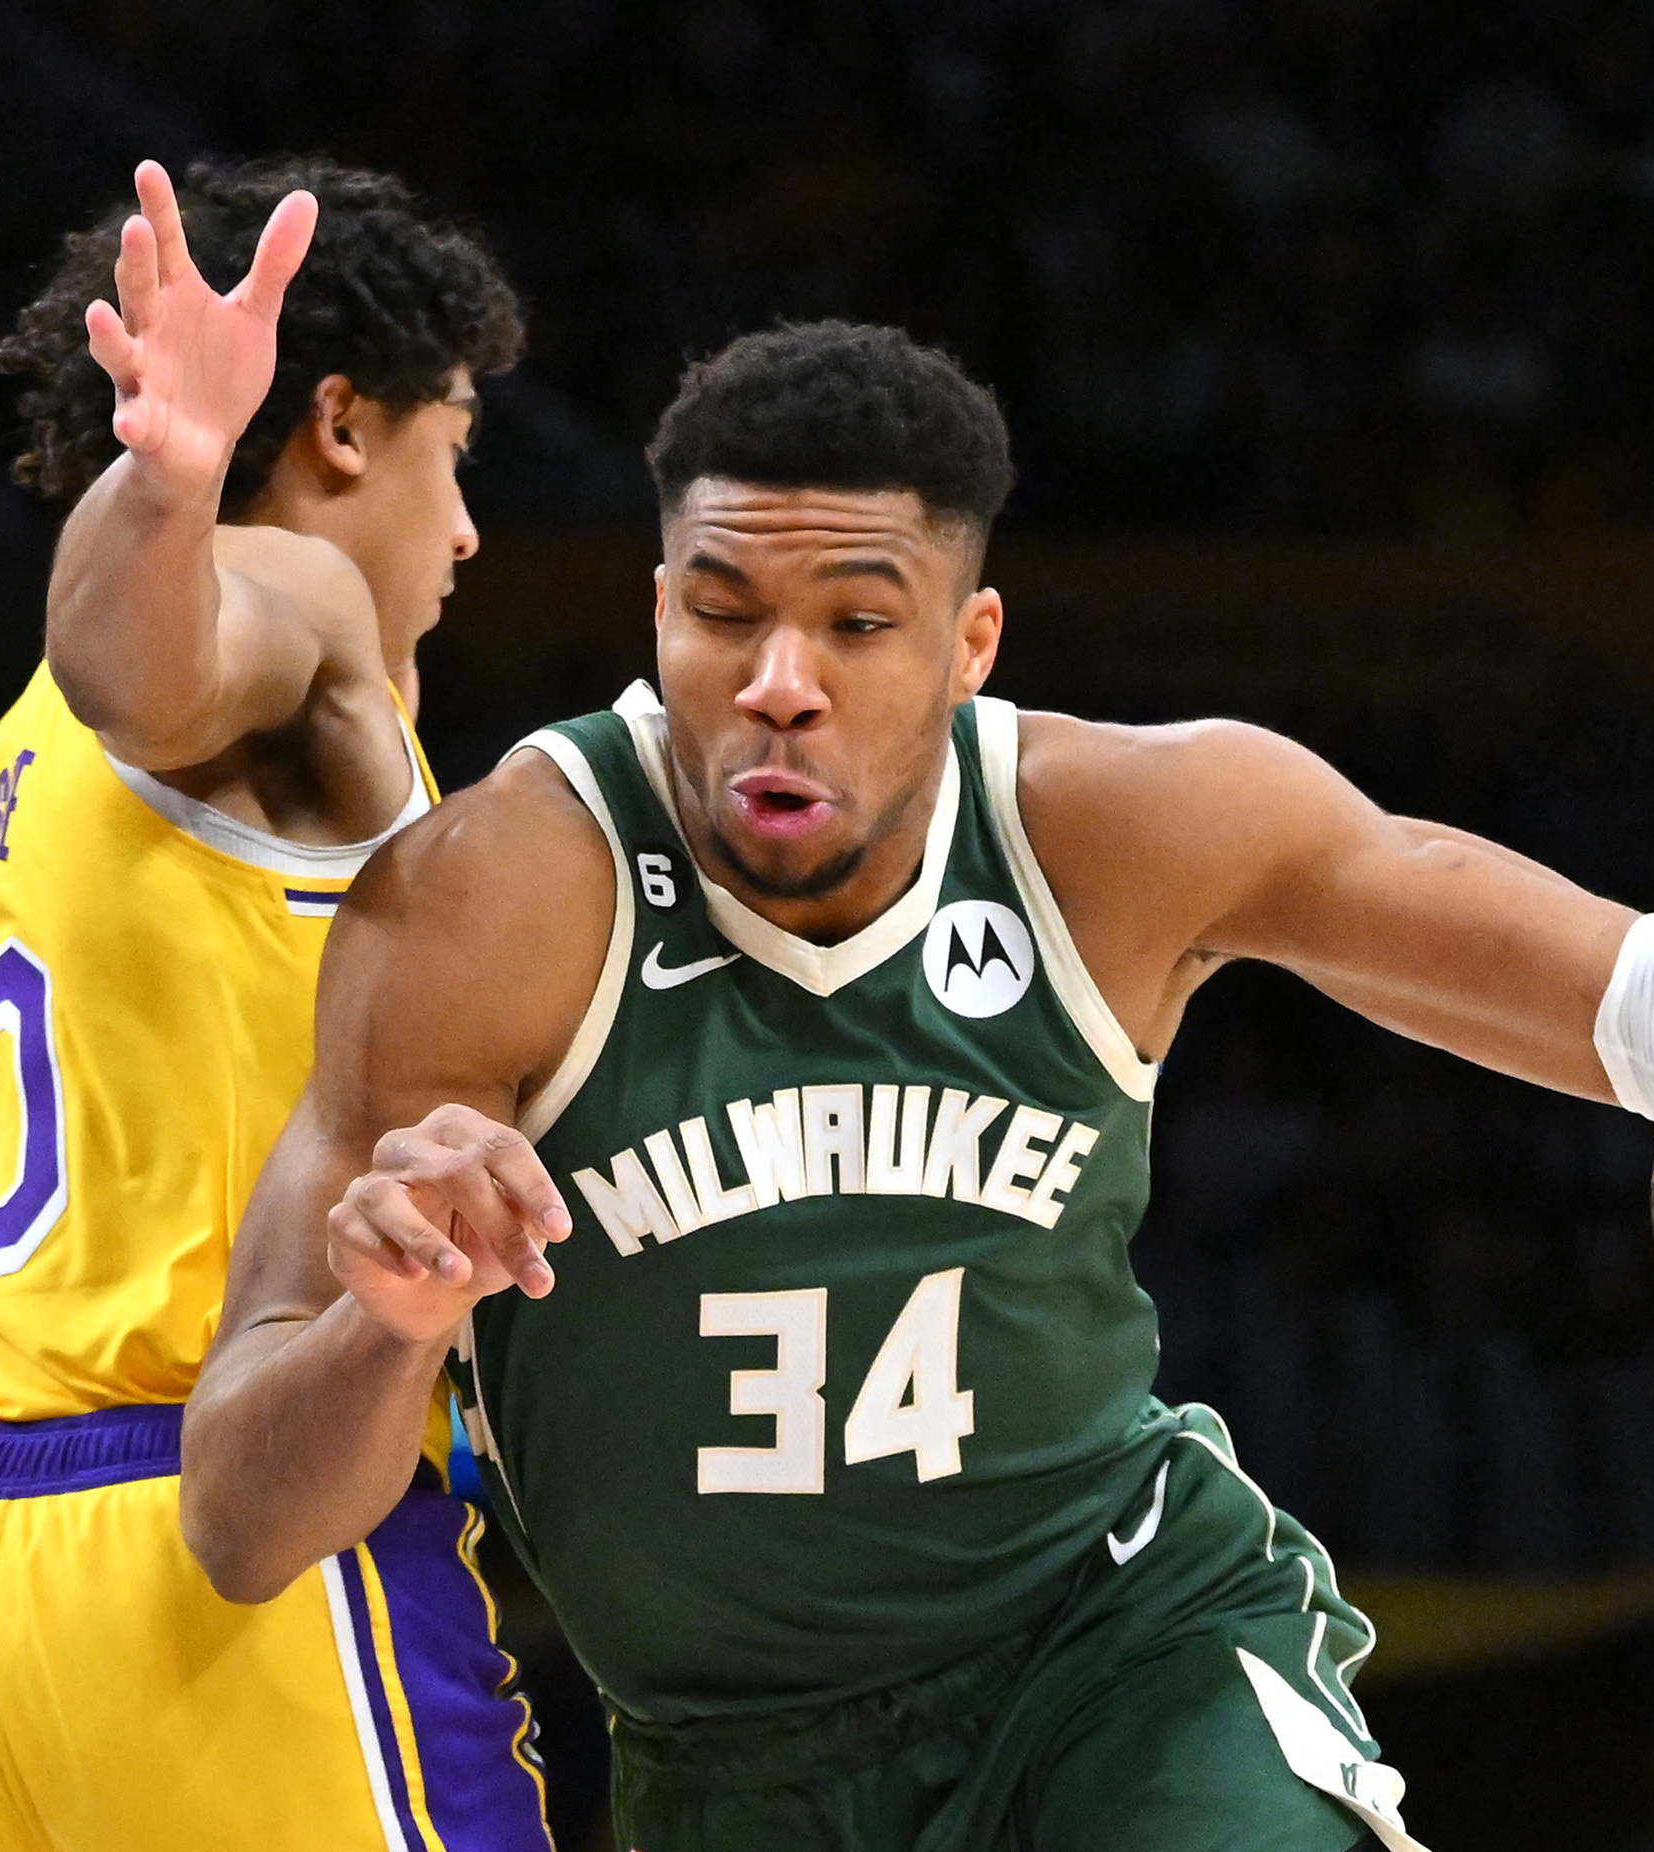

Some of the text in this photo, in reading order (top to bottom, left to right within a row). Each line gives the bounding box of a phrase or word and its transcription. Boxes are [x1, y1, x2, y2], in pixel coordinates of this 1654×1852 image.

[637, 852, 678, 908] 6
[571, 1084, 1100, 1257] MILWAUKEE
[698, 1267, 974, 1494] 34
